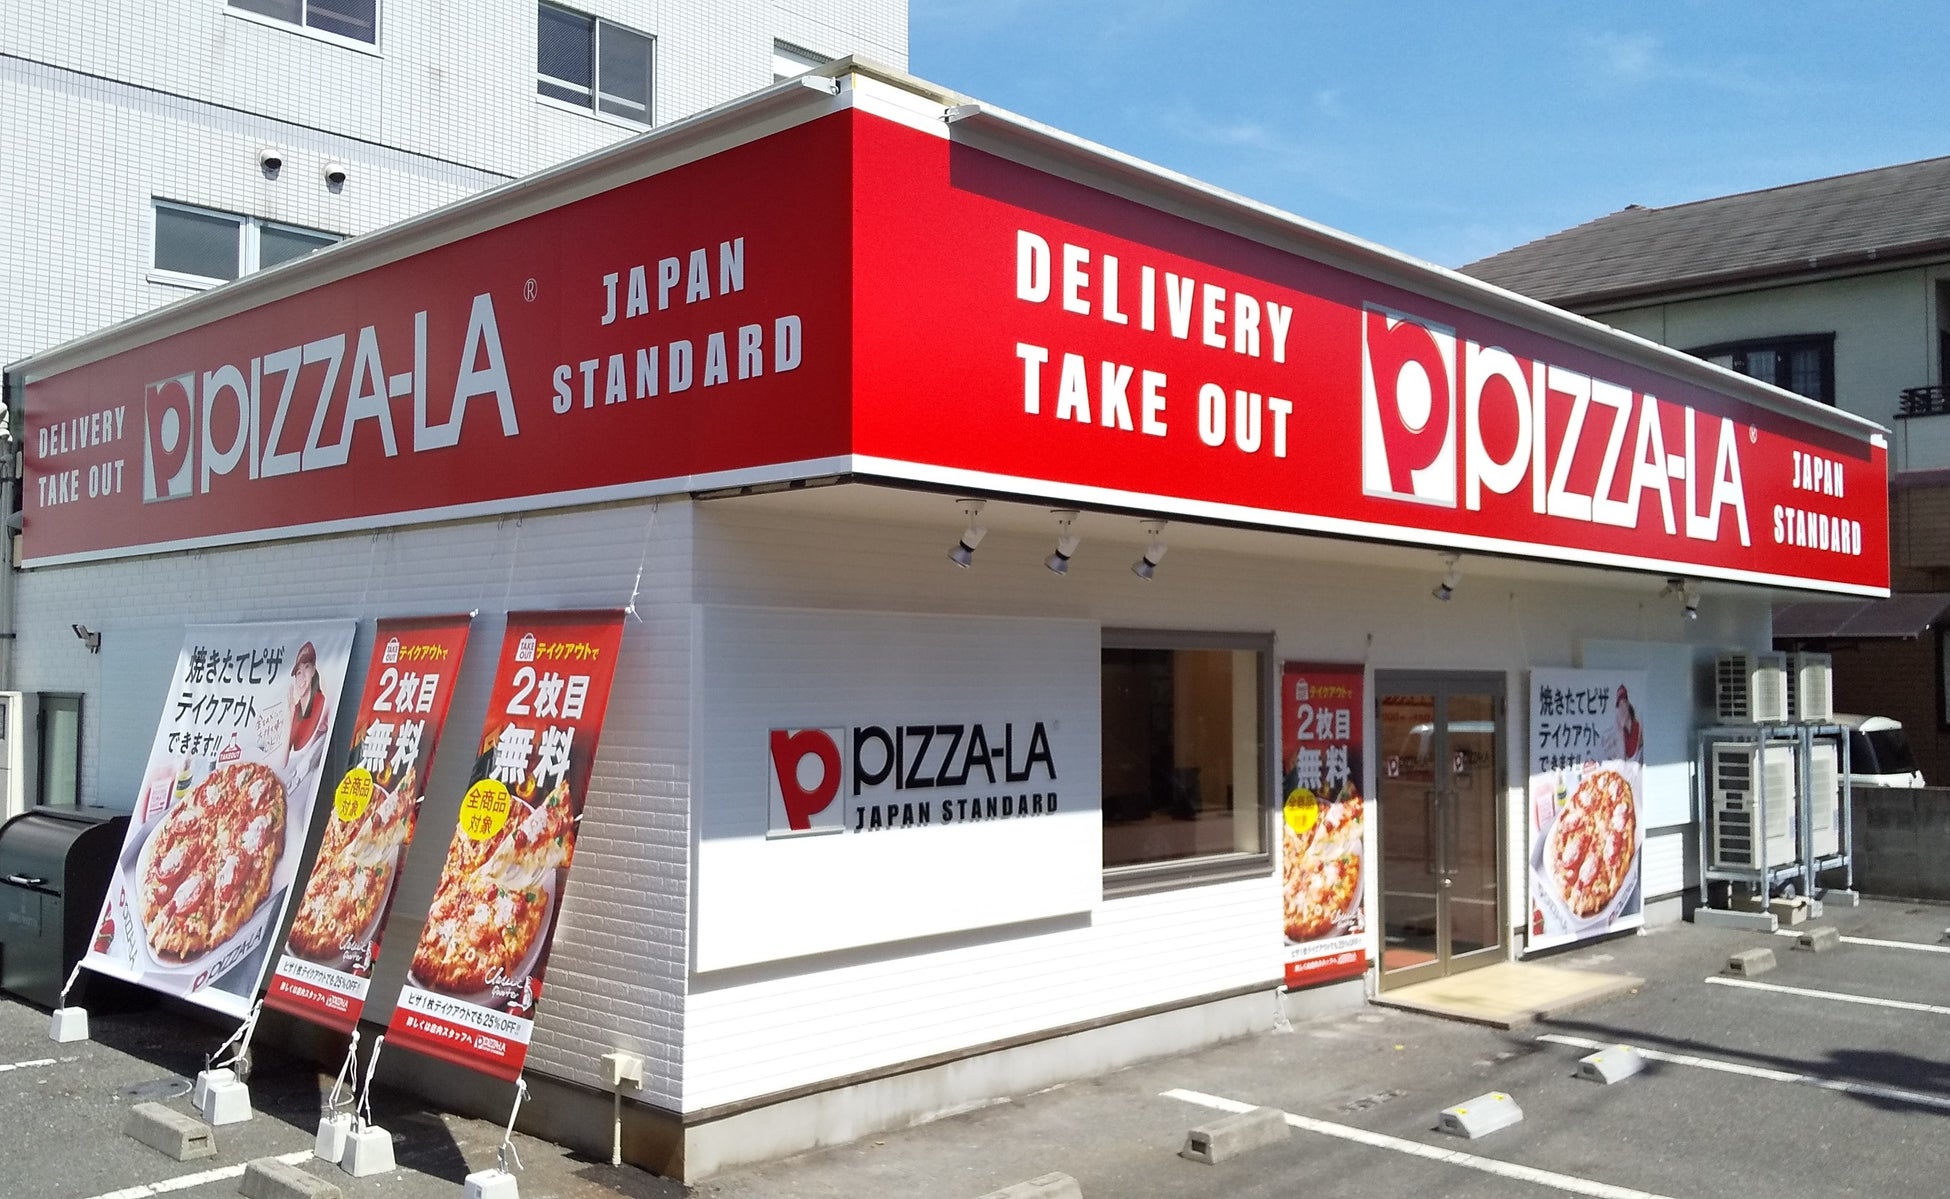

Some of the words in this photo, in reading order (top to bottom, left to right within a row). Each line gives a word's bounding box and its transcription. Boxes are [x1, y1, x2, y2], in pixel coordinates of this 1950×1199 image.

[601, 237, 744, 326] JAPAN
[1016, 229, 1293, 364] DELIVERY
[552, 315, 802, 415] STANDARD
[1016, 342, 1168, 437] TAKE
[1198, 383, 1293, 458] OUT
[39, 405, 126, 459] DELIVERY
[38, 469, 79, 508] TAKE
[88, 460, 125, 498] OUT
[1793, 450, 1844, 498] JAPAN
[1773, 504, 1862, 556] STANDARD
[185, 645, 285, 686] 焼きたてピザ
[385, 653, 397, 662] OUT
[399, 643, 449, 661] テイクアウトで
[519, 651, 533, 660] OUT
[520, 642, 535, 651] TAKE
[535, 641, 600, 661] テイクアウトで
[373, 667, 440, 713] 2枚目
[506, 666, 591, 720] 2枚目
[1540, 684, 1609, 716] 焼きたてピザ
[175, 692, 256, 729] テイクアウト
[1297, 703, 1350, 740] 2枚目
[357, 718, 426, 775] 無料
[1539, 722, 1600, 749] テイクアウト
[489, 722, 576, 789] 無料
[1297, 744, 1351, 789] 無料
[341, 776, 371, 799] 全商品
[467, 787, 508, 814] 全商品
[341, 801, 359, 817] 対象
[468, 815, 493, 835] 対象
[855, 801, 930, 830] JAPAN
[942, 792, 1058, 823] STANDARD
